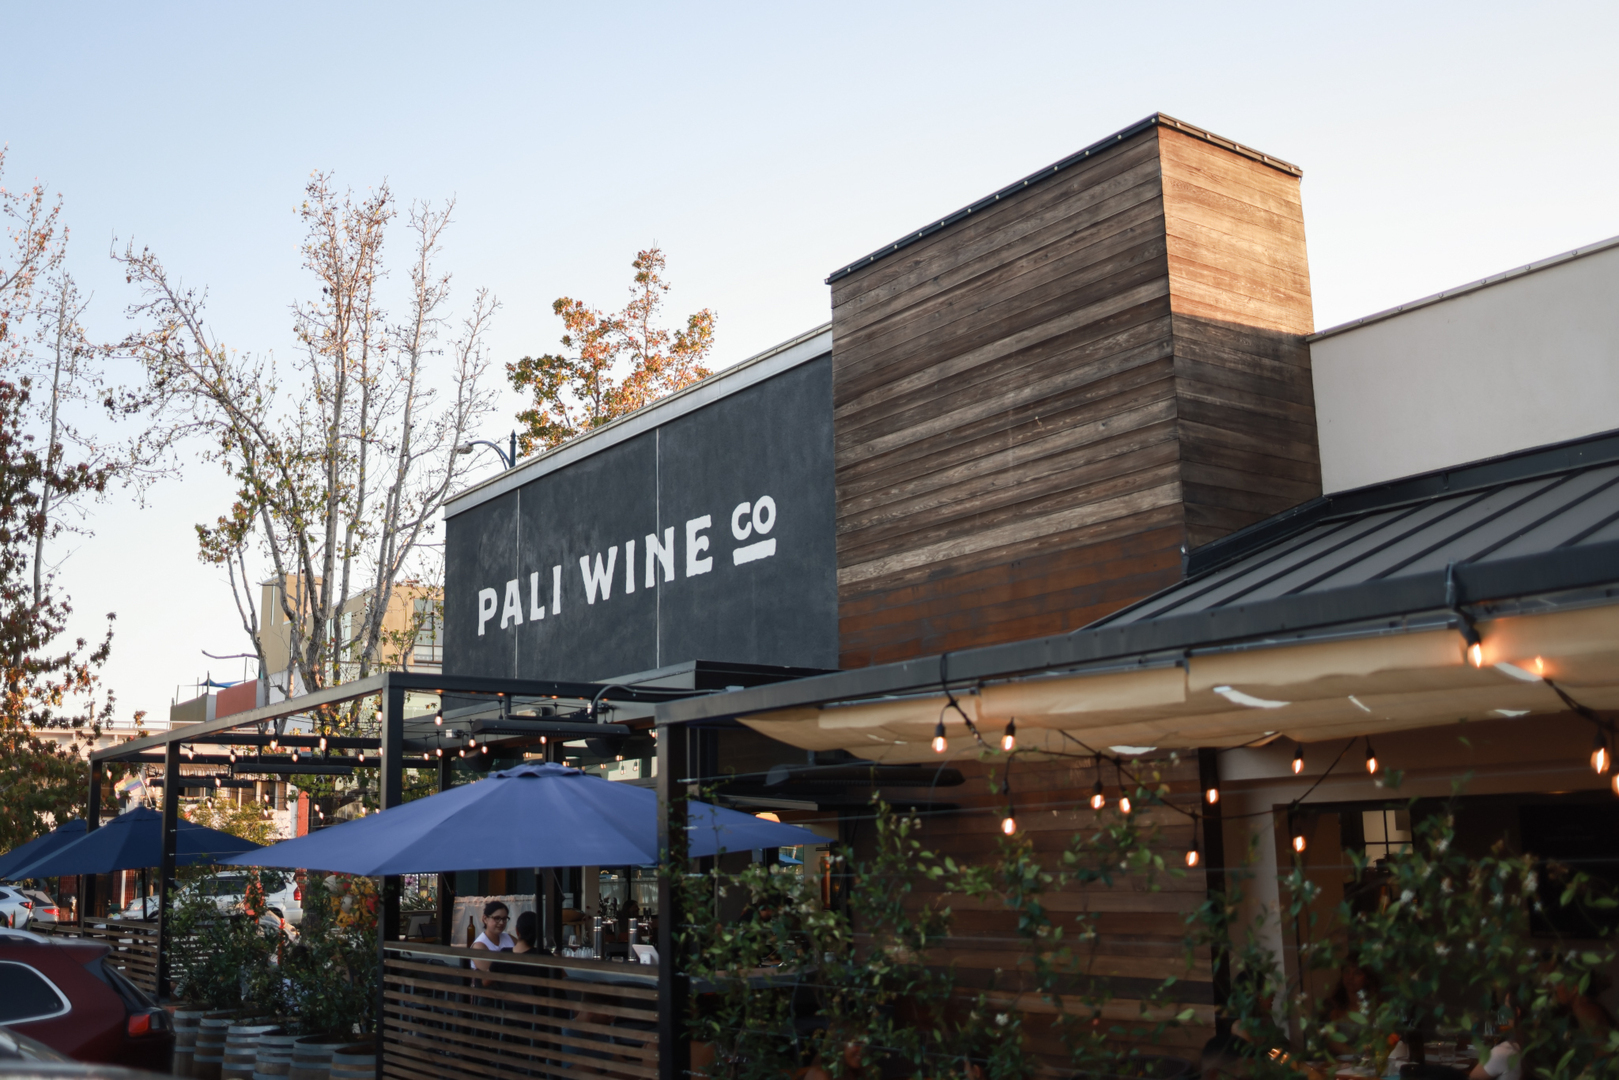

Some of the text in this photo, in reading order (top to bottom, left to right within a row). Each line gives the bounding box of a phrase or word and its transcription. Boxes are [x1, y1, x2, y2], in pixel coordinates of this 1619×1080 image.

[477, 495, 777, 637] PALI WINE CO
